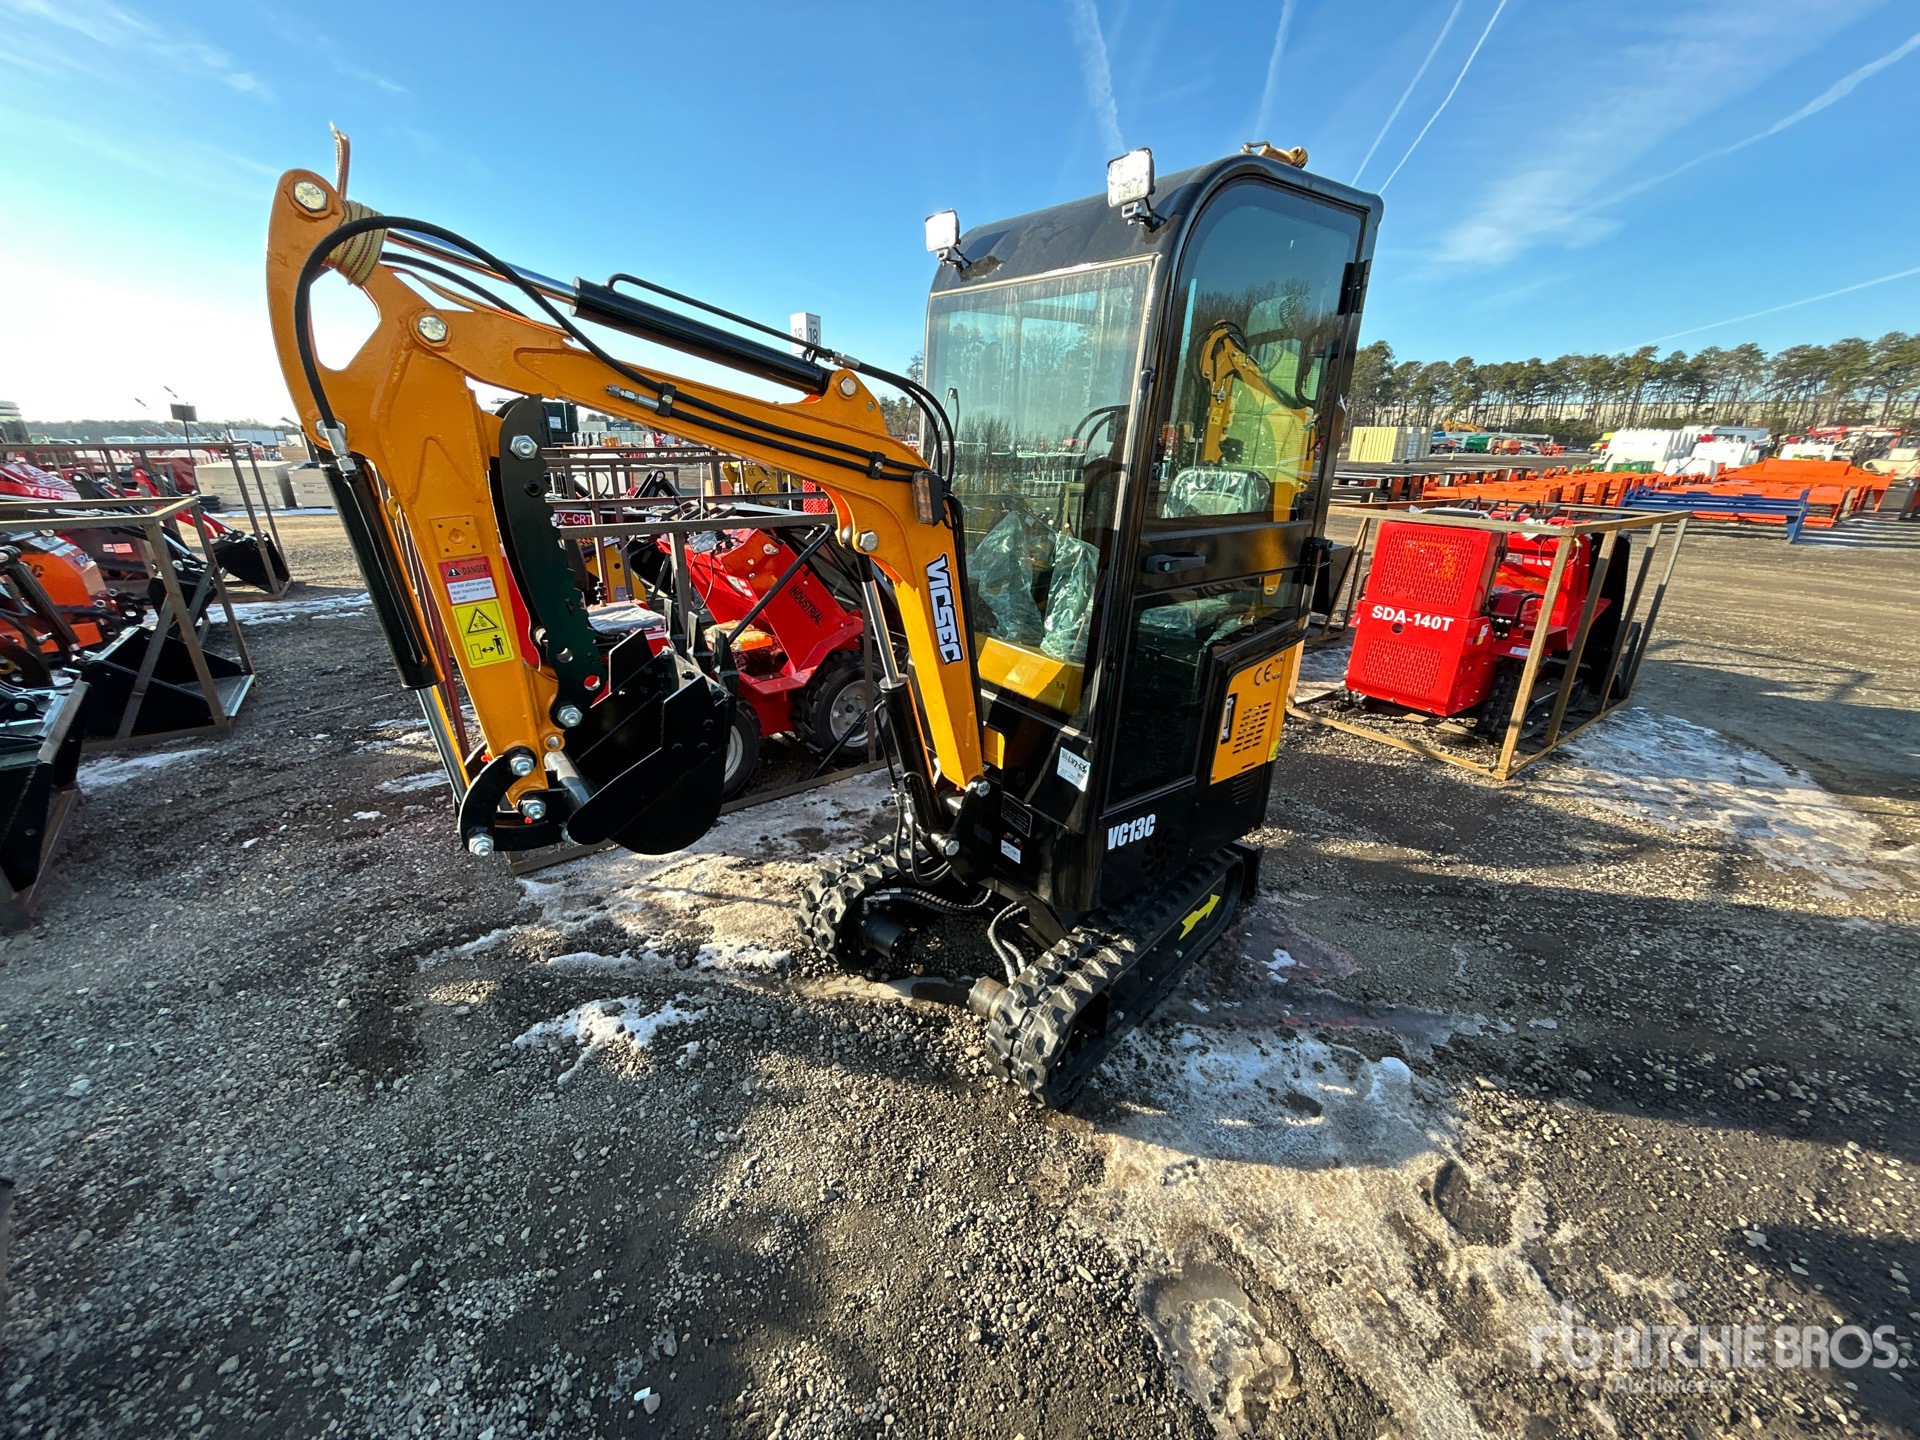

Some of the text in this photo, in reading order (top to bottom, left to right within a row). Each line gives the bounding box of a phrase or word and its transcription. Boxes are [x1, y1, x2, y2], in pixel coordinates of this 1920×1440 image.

[808, 327, 818, 344] 18
[462, 564, 488, 575] DANGER
[476, 579, 491, 587] people
[789, 584, 824, 625] INDUSTRIAL
[1371, 605, 1454, 632] SDA-140T
[1254, 663, 1272, 686] CE
[1108, 813, 1156, 850] VC13C
